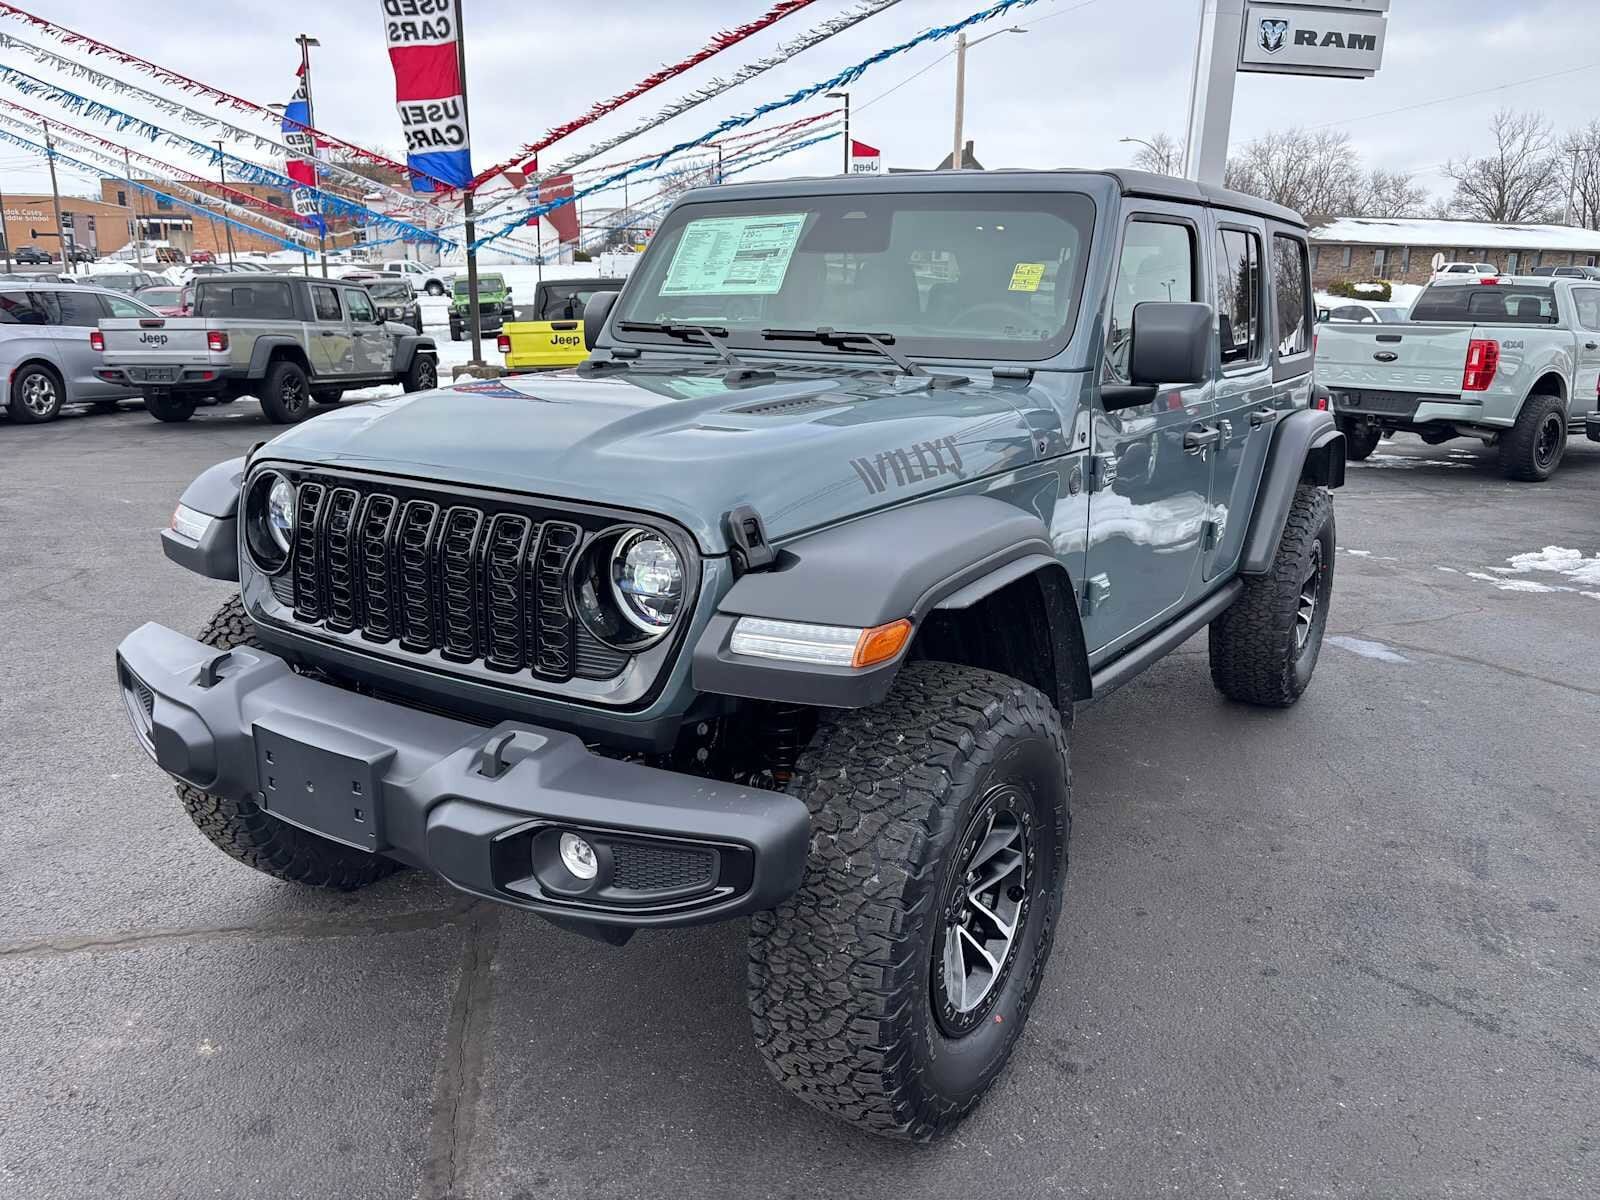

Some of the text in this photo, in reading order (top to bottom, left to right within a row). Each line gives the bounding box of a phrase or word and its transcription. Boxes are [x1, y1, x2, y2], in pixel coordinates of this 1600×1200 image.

[1294, 29, 1377, 51] RAM
[139, 332, 168, 345] Jeep
[550, 334, 581, 347] Jeep
[848, 434, 968, 495] WILLYS
